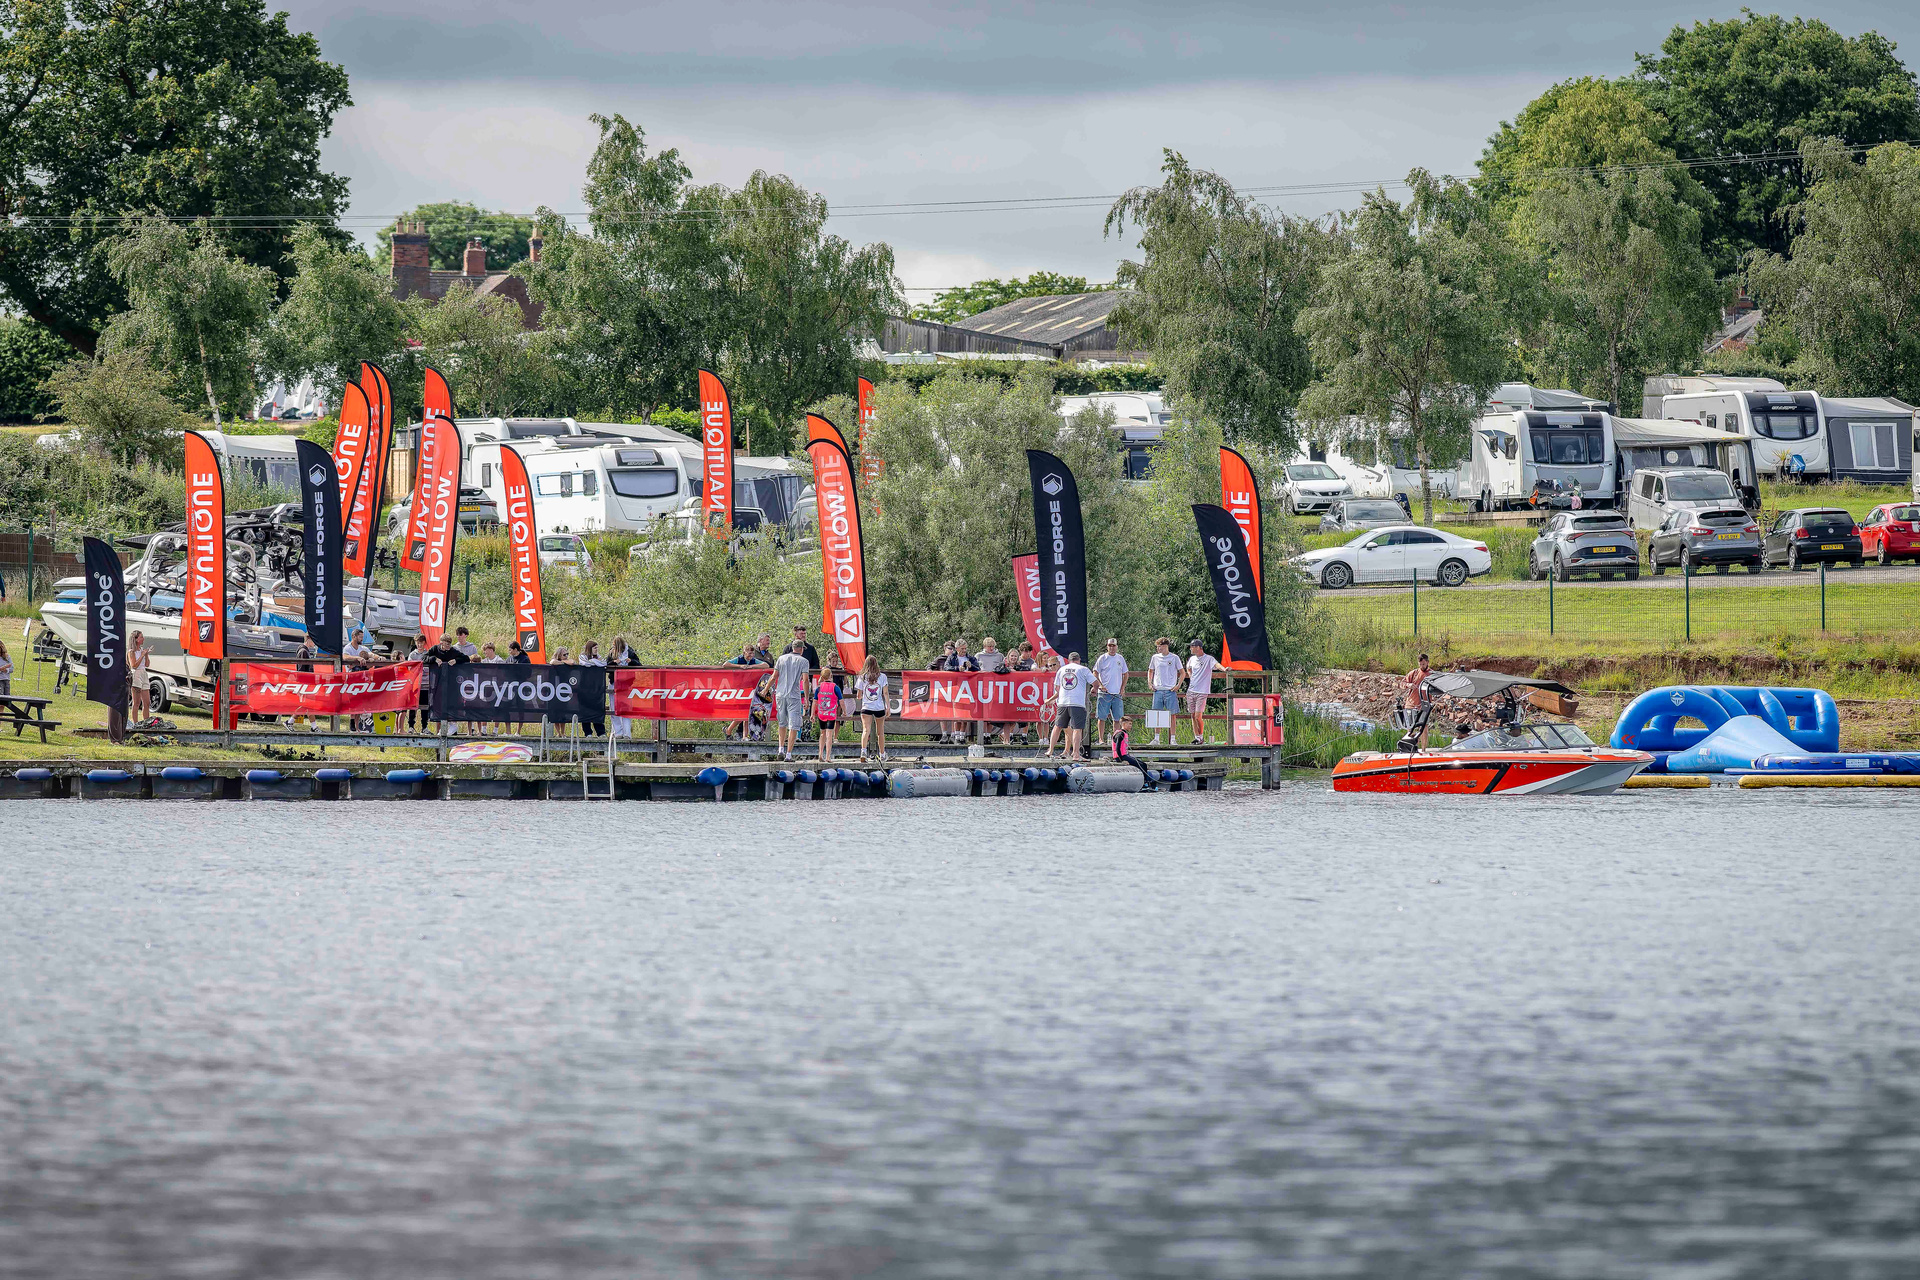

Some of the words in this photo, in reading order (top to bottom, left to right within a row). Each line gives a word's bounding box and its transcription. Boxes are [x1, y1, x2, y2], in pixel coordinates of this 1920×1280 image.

[314, 491, 325, 557] FORCE
[427, 469, 454, 583] FOLLOW.
[827, 486, 857, 599] FOLLOW.
[1049, 500, 1065, 565] FORCE
[315, 561, 327, 626] LIQUID
[1055, 570, 1070, 635] LIQUID
[260, 679, 408, 696] NAUTIQUE
[627, 688, 756, 702] NAUTIQU
[933, 680, 1049, 706] NAUTIQ
